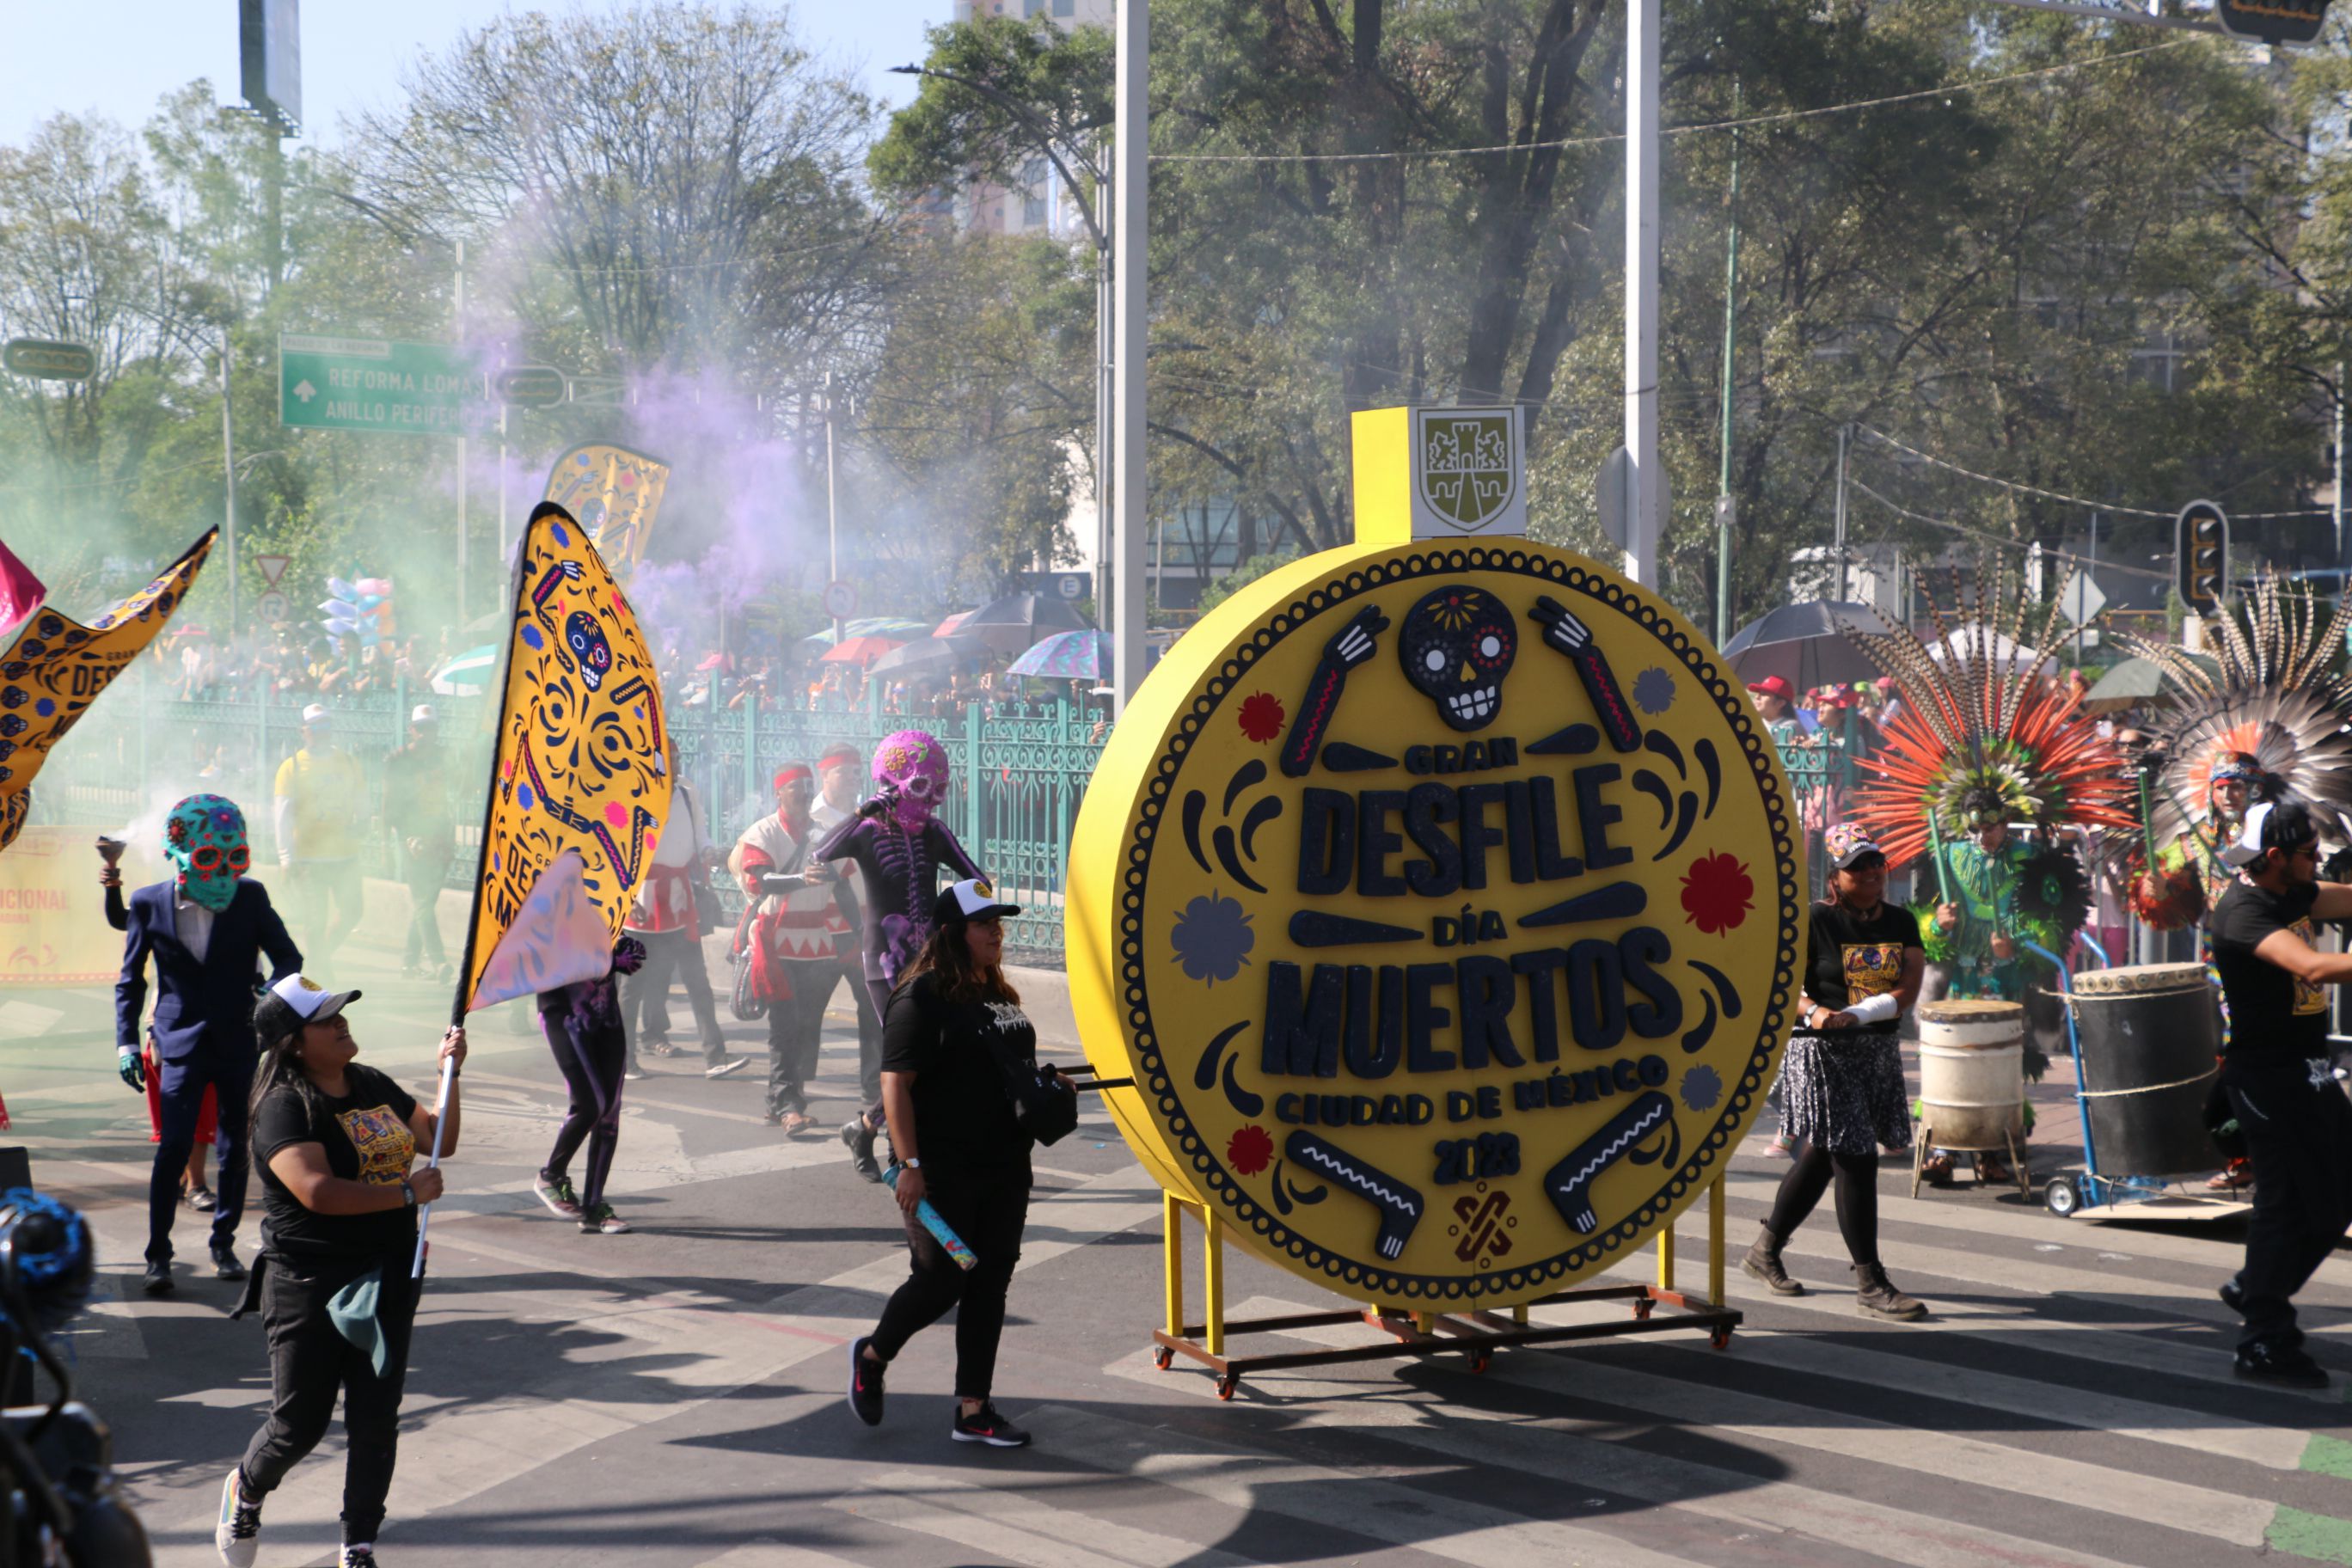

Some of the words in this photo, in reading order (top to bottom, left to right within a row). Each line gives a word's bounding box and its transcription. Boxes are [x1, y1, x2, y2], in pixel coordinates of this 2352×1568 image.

[328, 368, 414, 391] REFORMA
[423, 375, 484, 395] LOMAS
[325, 401, 385, 422] ANILLO
[1405, 736, 1519, 774] GRAN
[1297, 763, 1633, 897] DESFILE
[1432, 903, 1509, 946] DÍA
[1261, 926, 1683, 1080] MUERTOS
[1276, 1092, 1435, 1126] CIUDAD
[1447, 1085, 1503, 1123] DE
[1514, 1054, 1669, 1112] MÉXICO
[1433, 1131, 1521, 1185] 2023
